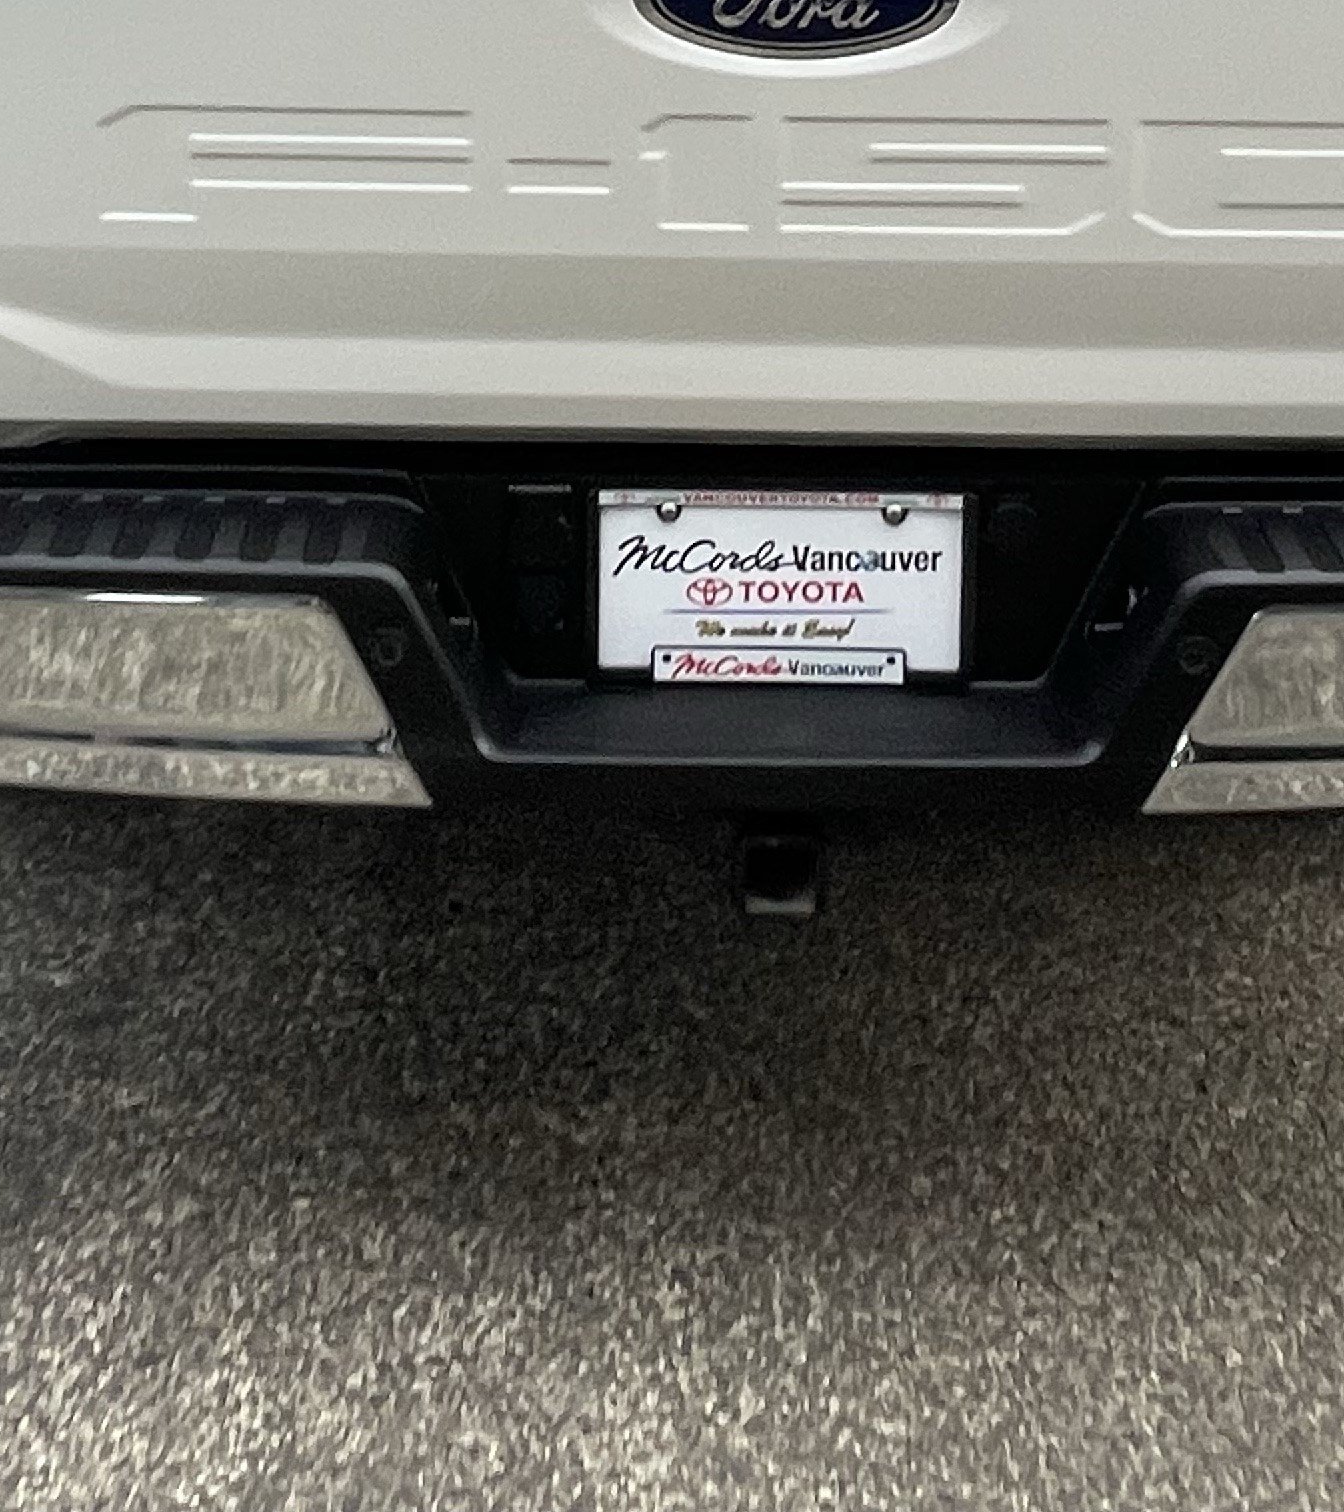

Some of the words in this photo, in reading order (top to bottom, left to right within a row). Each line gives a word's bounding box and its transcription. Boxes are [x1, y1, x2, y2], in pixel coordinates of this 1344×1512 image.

[612, 533, 791, 577] McCords
[792, 544, 944, 573] Vancouver
[738, 580, 865, 604] TOYOTA
[670, 651, 783, 680] McCords
[788, 657, 885, 678] Vancouver
